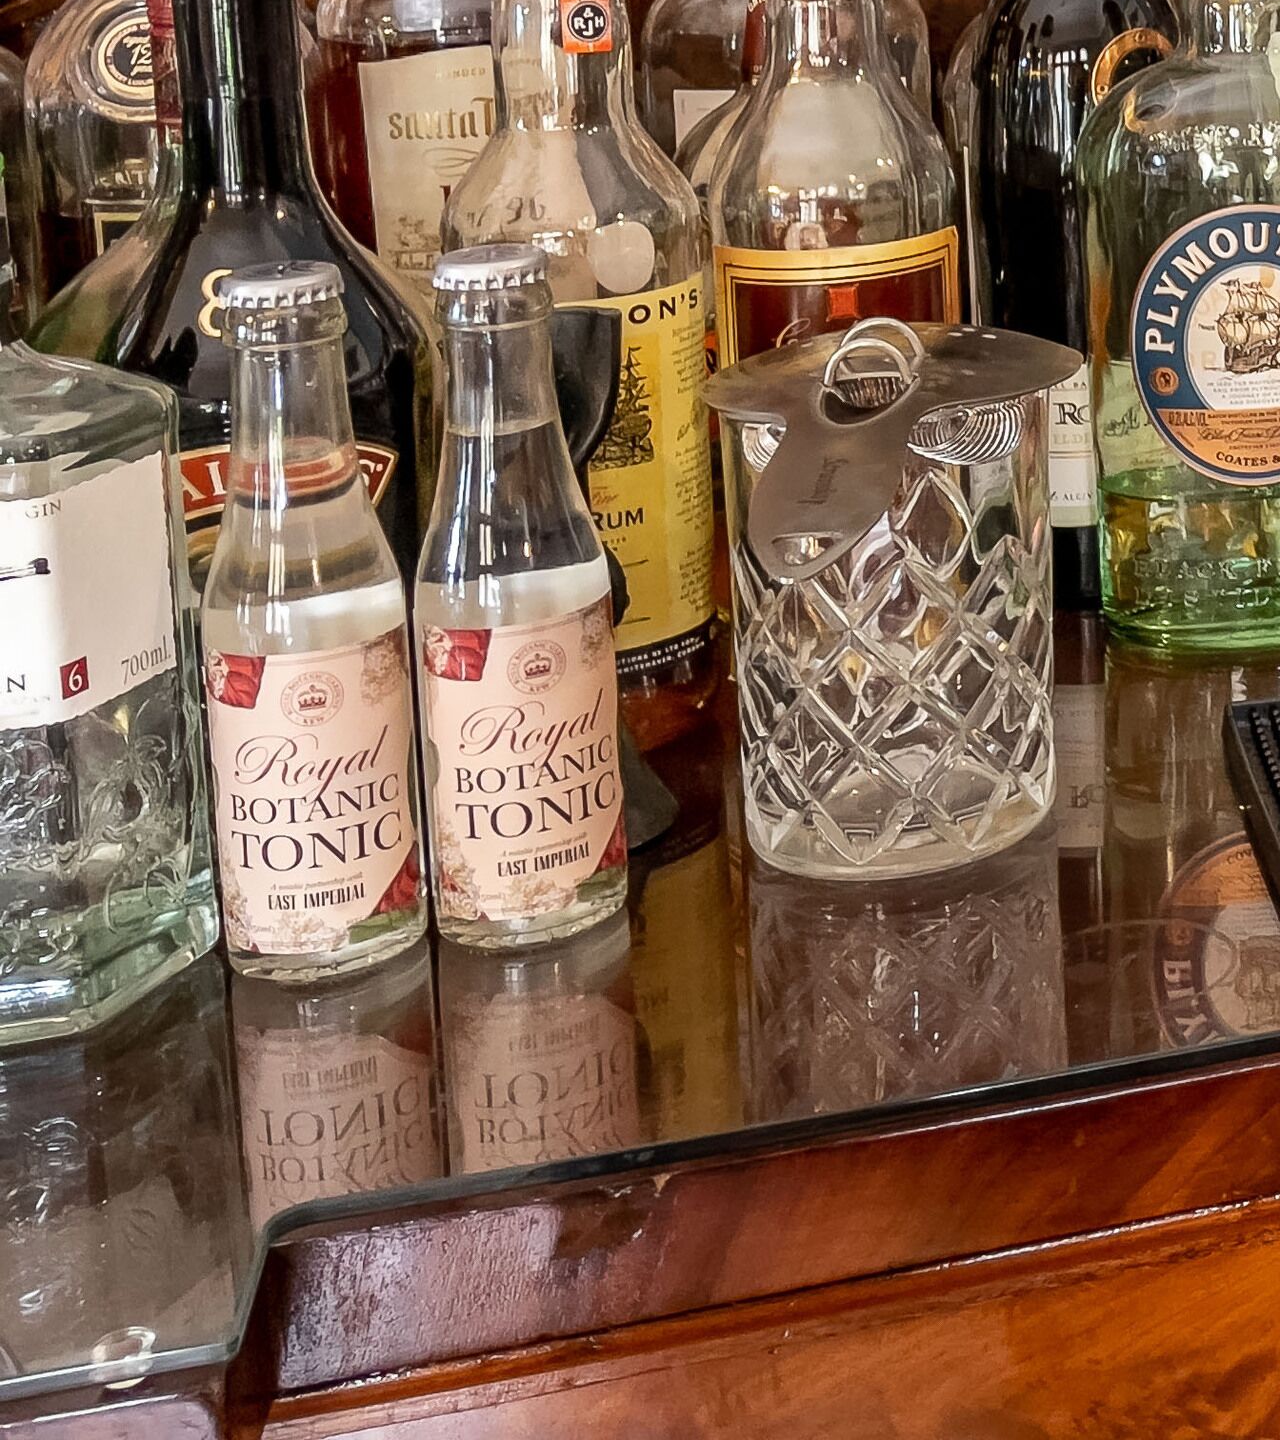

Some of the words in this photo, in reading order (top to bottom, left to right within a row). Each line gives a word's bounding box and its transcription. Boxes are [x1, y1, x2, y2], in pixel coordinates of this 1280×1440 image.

[1216, 451, 1268, 467] COATES
[24, 499, 62, 520] GIN
[590, 507, 644, 532] RUM
[67, 665, 84, 692] 6
[459, 688, 603, 774] Royal
[234, 724, 389, 806] Royal
[454, 735, 613, 794] BOTANIC
[230, 773, 399, 824] BOTANIC
[455, 770, 616, 839] TONIC
[231, 809, 402, 871] TONIC
[497, 857, 528, 877] EAST
[534, 842, 590, 874] IMPERIAL
[267, 890, 300, 911] EAST
[303, 881, 366, 909] IMPERIAL
